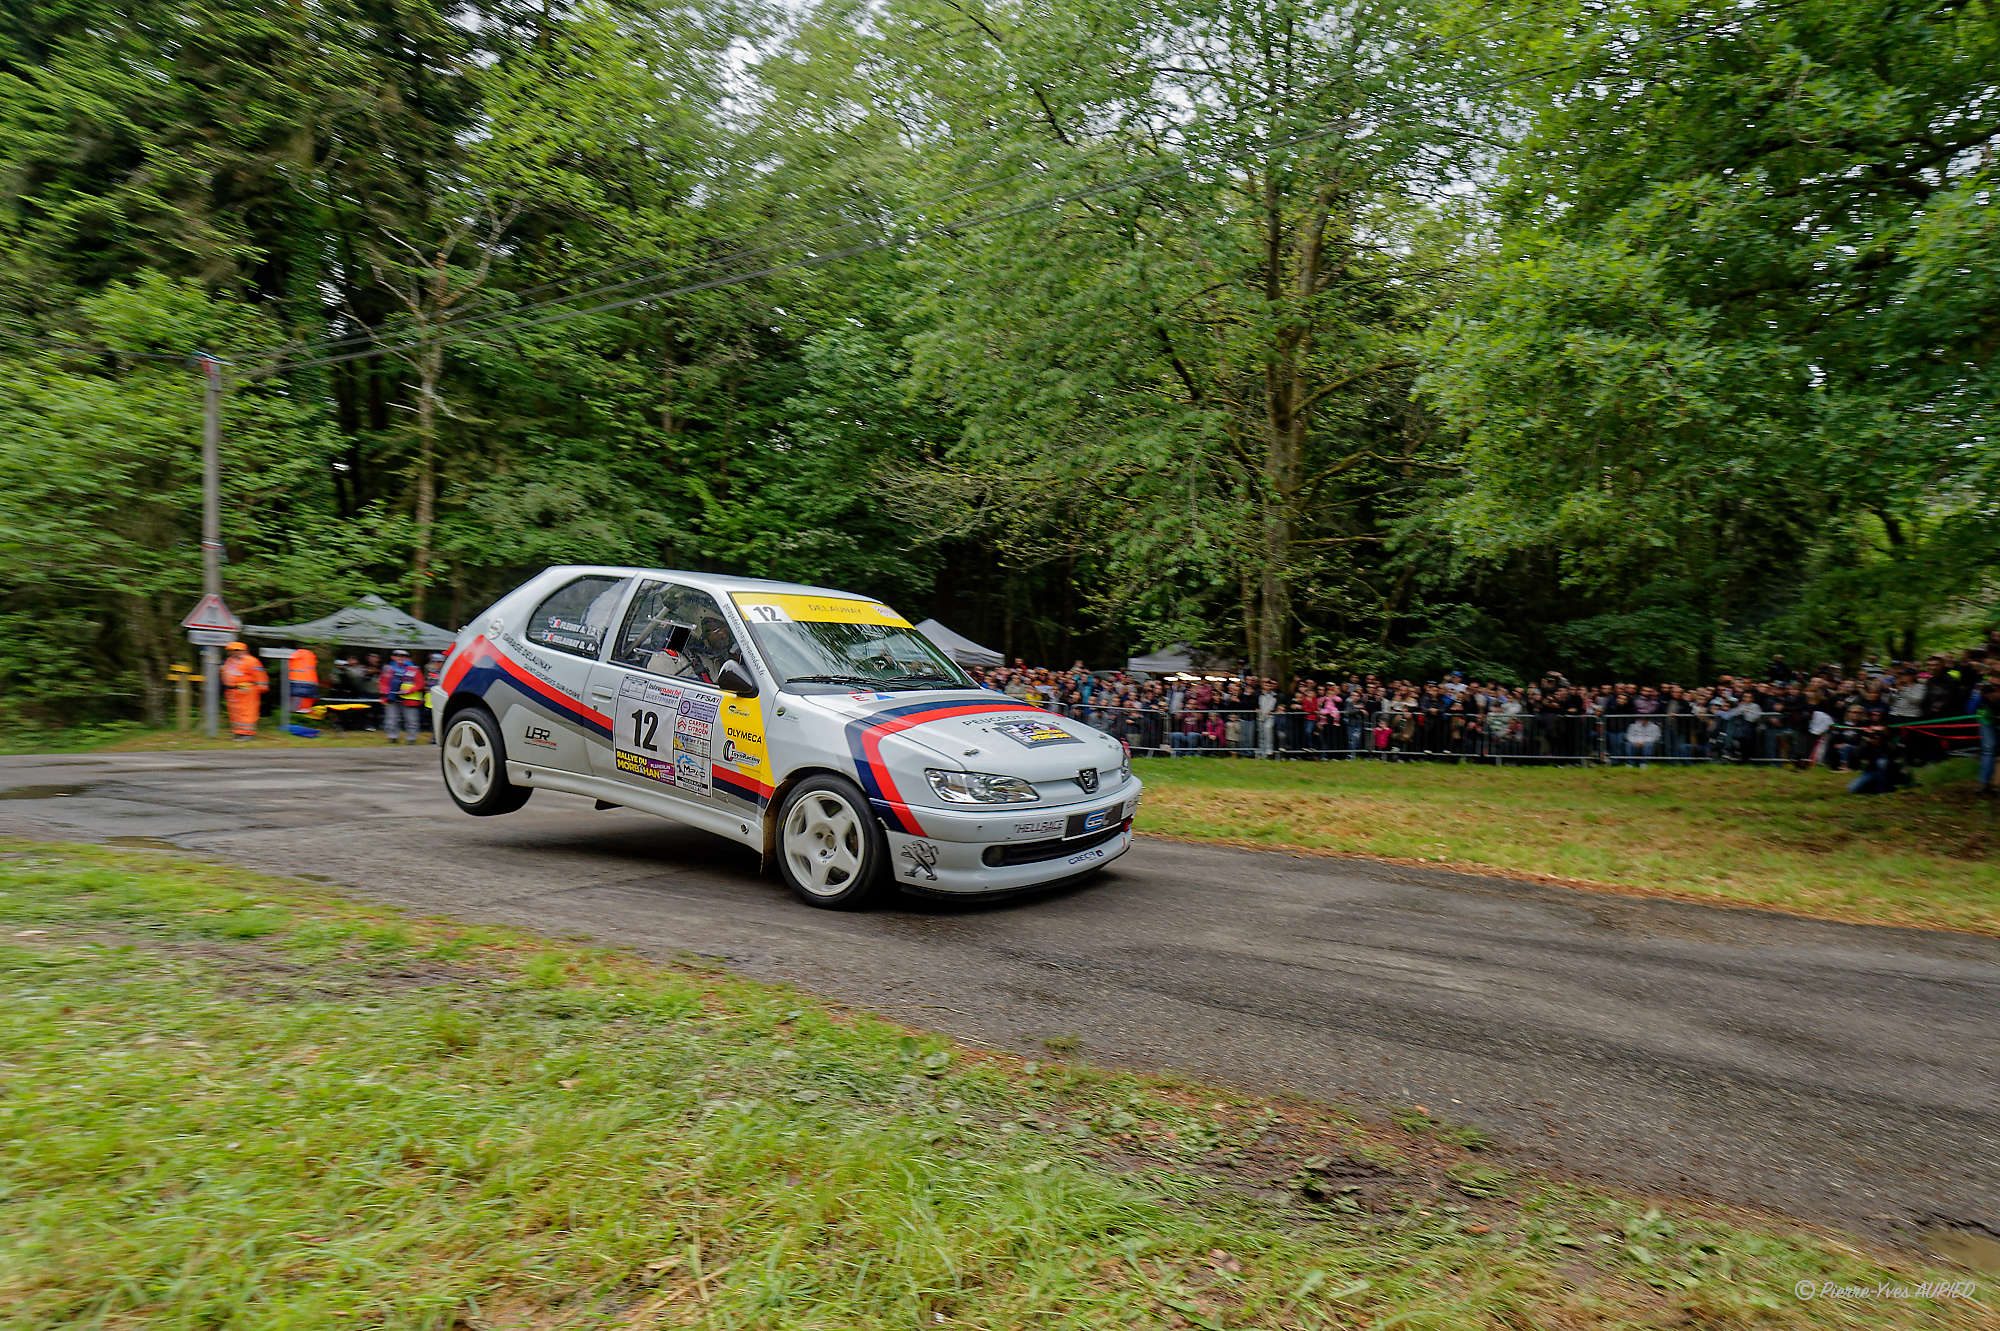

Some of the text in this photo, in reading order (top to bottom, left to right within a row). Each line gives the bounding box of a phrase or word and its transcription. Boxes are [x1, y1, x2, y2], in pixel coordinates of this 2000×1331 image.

[753, 605, 783, 622] 12
[695, 693, 716, 703] FFSA
[631, 708, 659, 752] 12
[727, 727, 762, 744] OLYMECA
[616, 750, 648, 766] RALLYE DU
